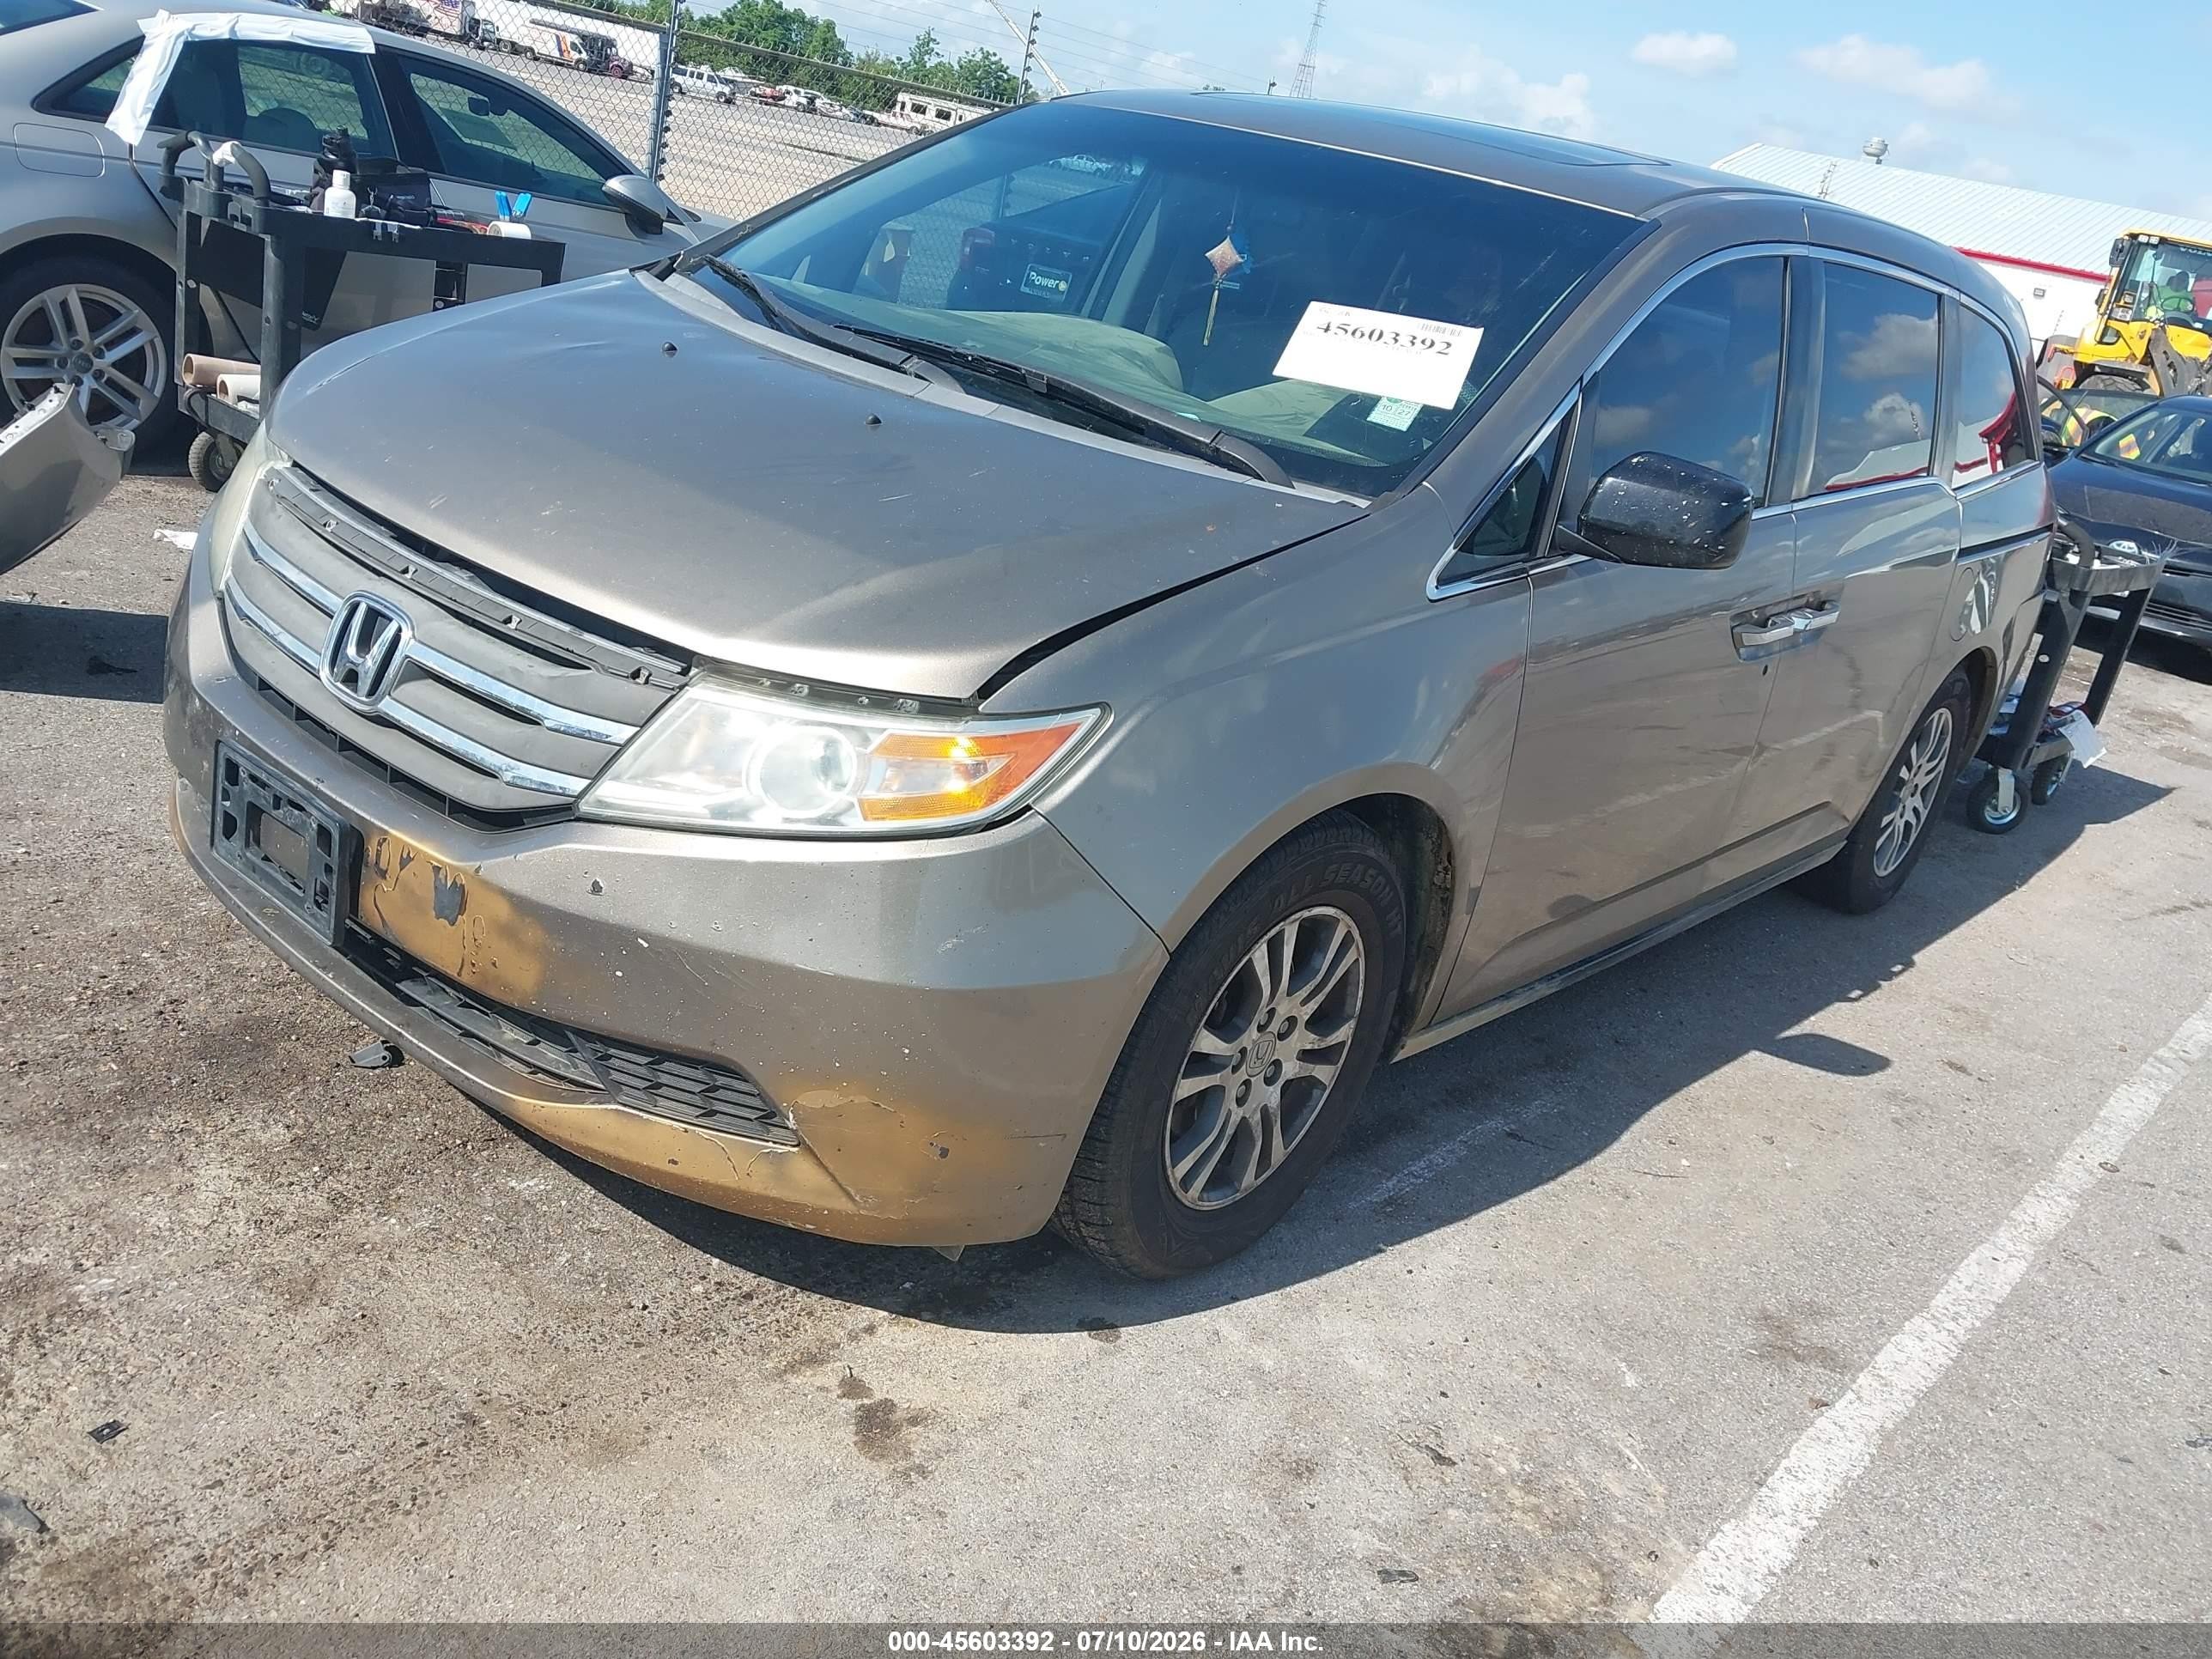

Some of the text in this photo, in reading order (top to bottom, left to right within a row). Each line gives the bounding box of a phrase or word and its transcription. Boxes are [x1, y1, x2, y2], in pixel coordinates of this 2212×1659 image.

[1029, 271, 1059, 289] Power
[1316, 320, 1453, 356] 45603392
[1319, 863, 1394, 907] SEASON
